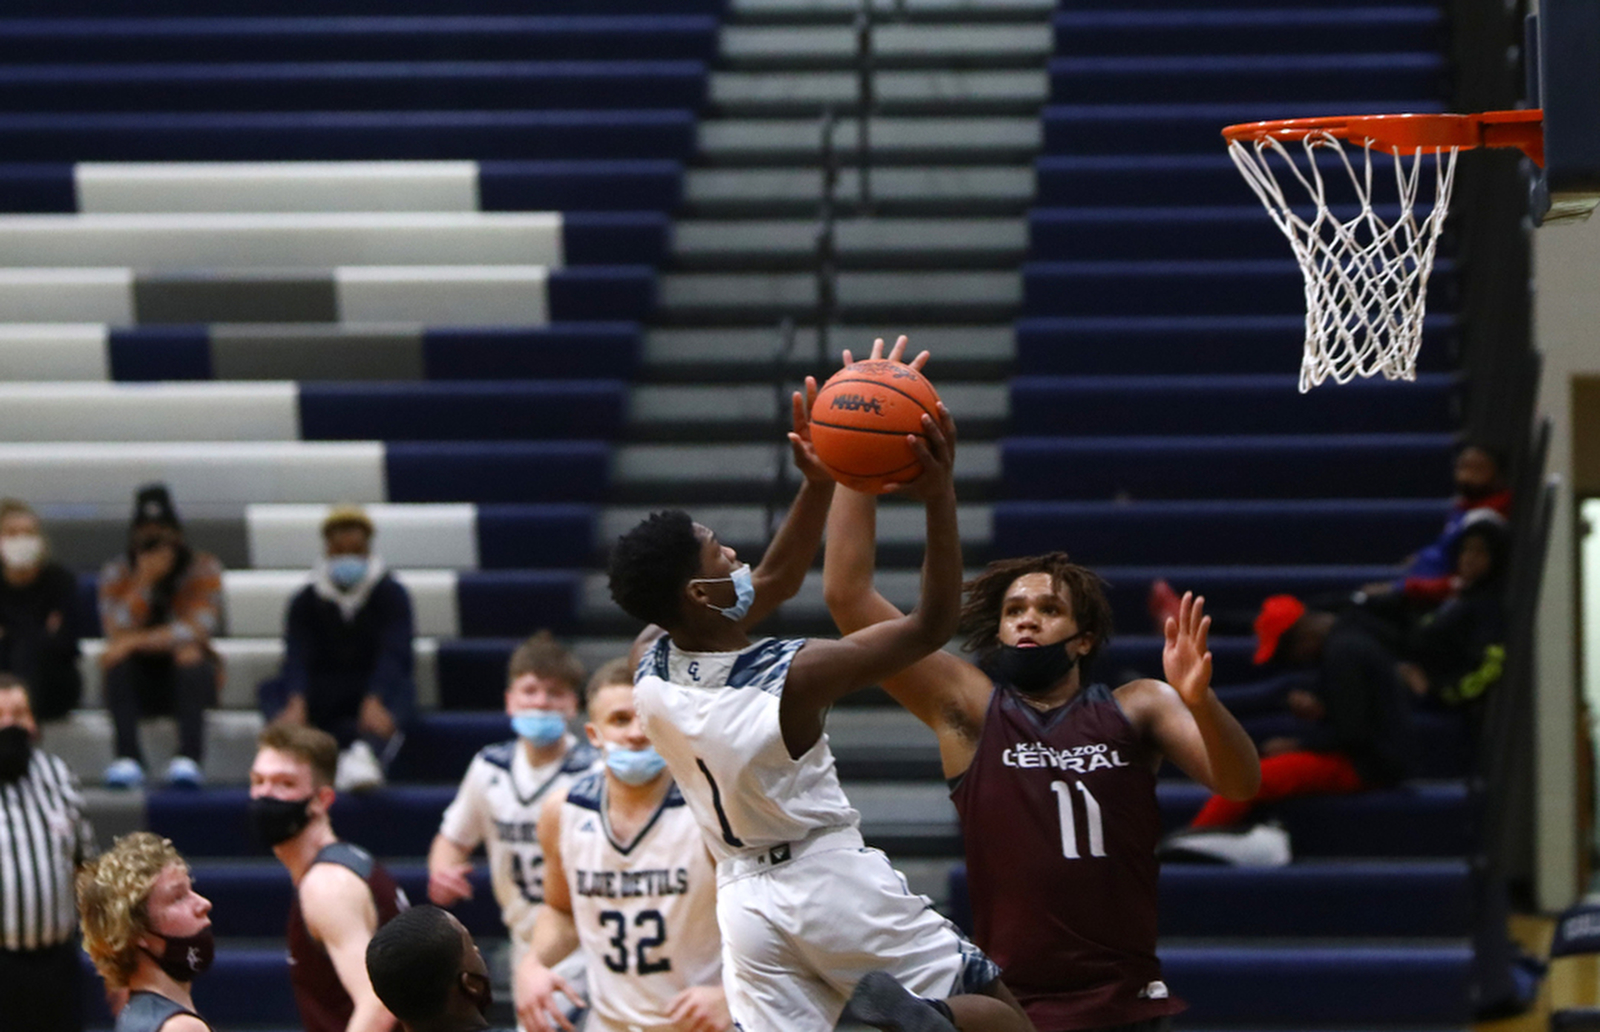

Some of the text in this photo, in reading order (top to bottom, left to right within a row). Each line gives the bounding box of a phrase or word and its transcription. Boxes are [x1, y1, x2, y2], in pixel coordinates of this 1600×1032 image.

[696, 757, 744, 847] 1
[1051, 780, 1107, 859] 11
[599, 910, 672, 975] 32
